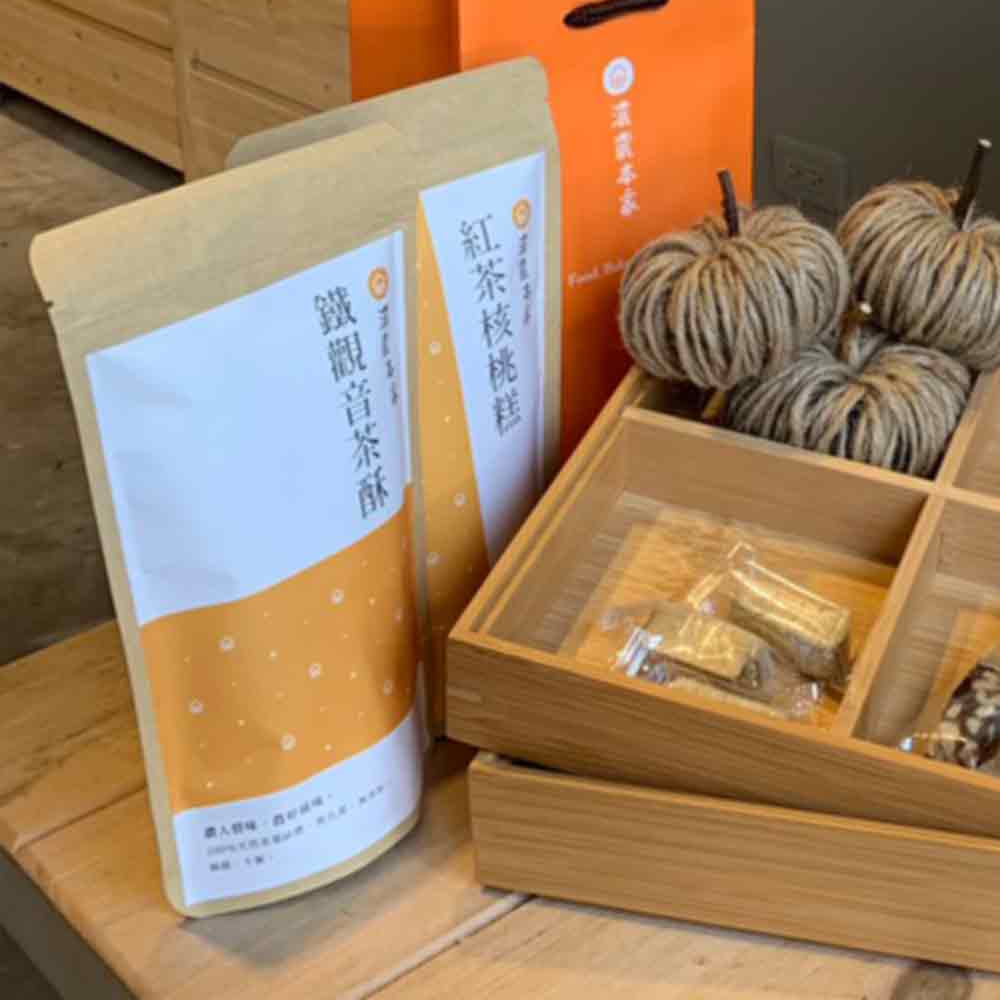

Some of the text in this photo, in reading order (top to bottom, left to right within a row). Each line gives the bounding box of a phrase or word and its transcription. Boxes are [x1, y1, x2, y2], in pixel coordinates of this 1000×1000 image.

[313, 285, 389, 519] 鐵觀音茶酥
[458, 212, 521, 437] 紅茶核桃糕
